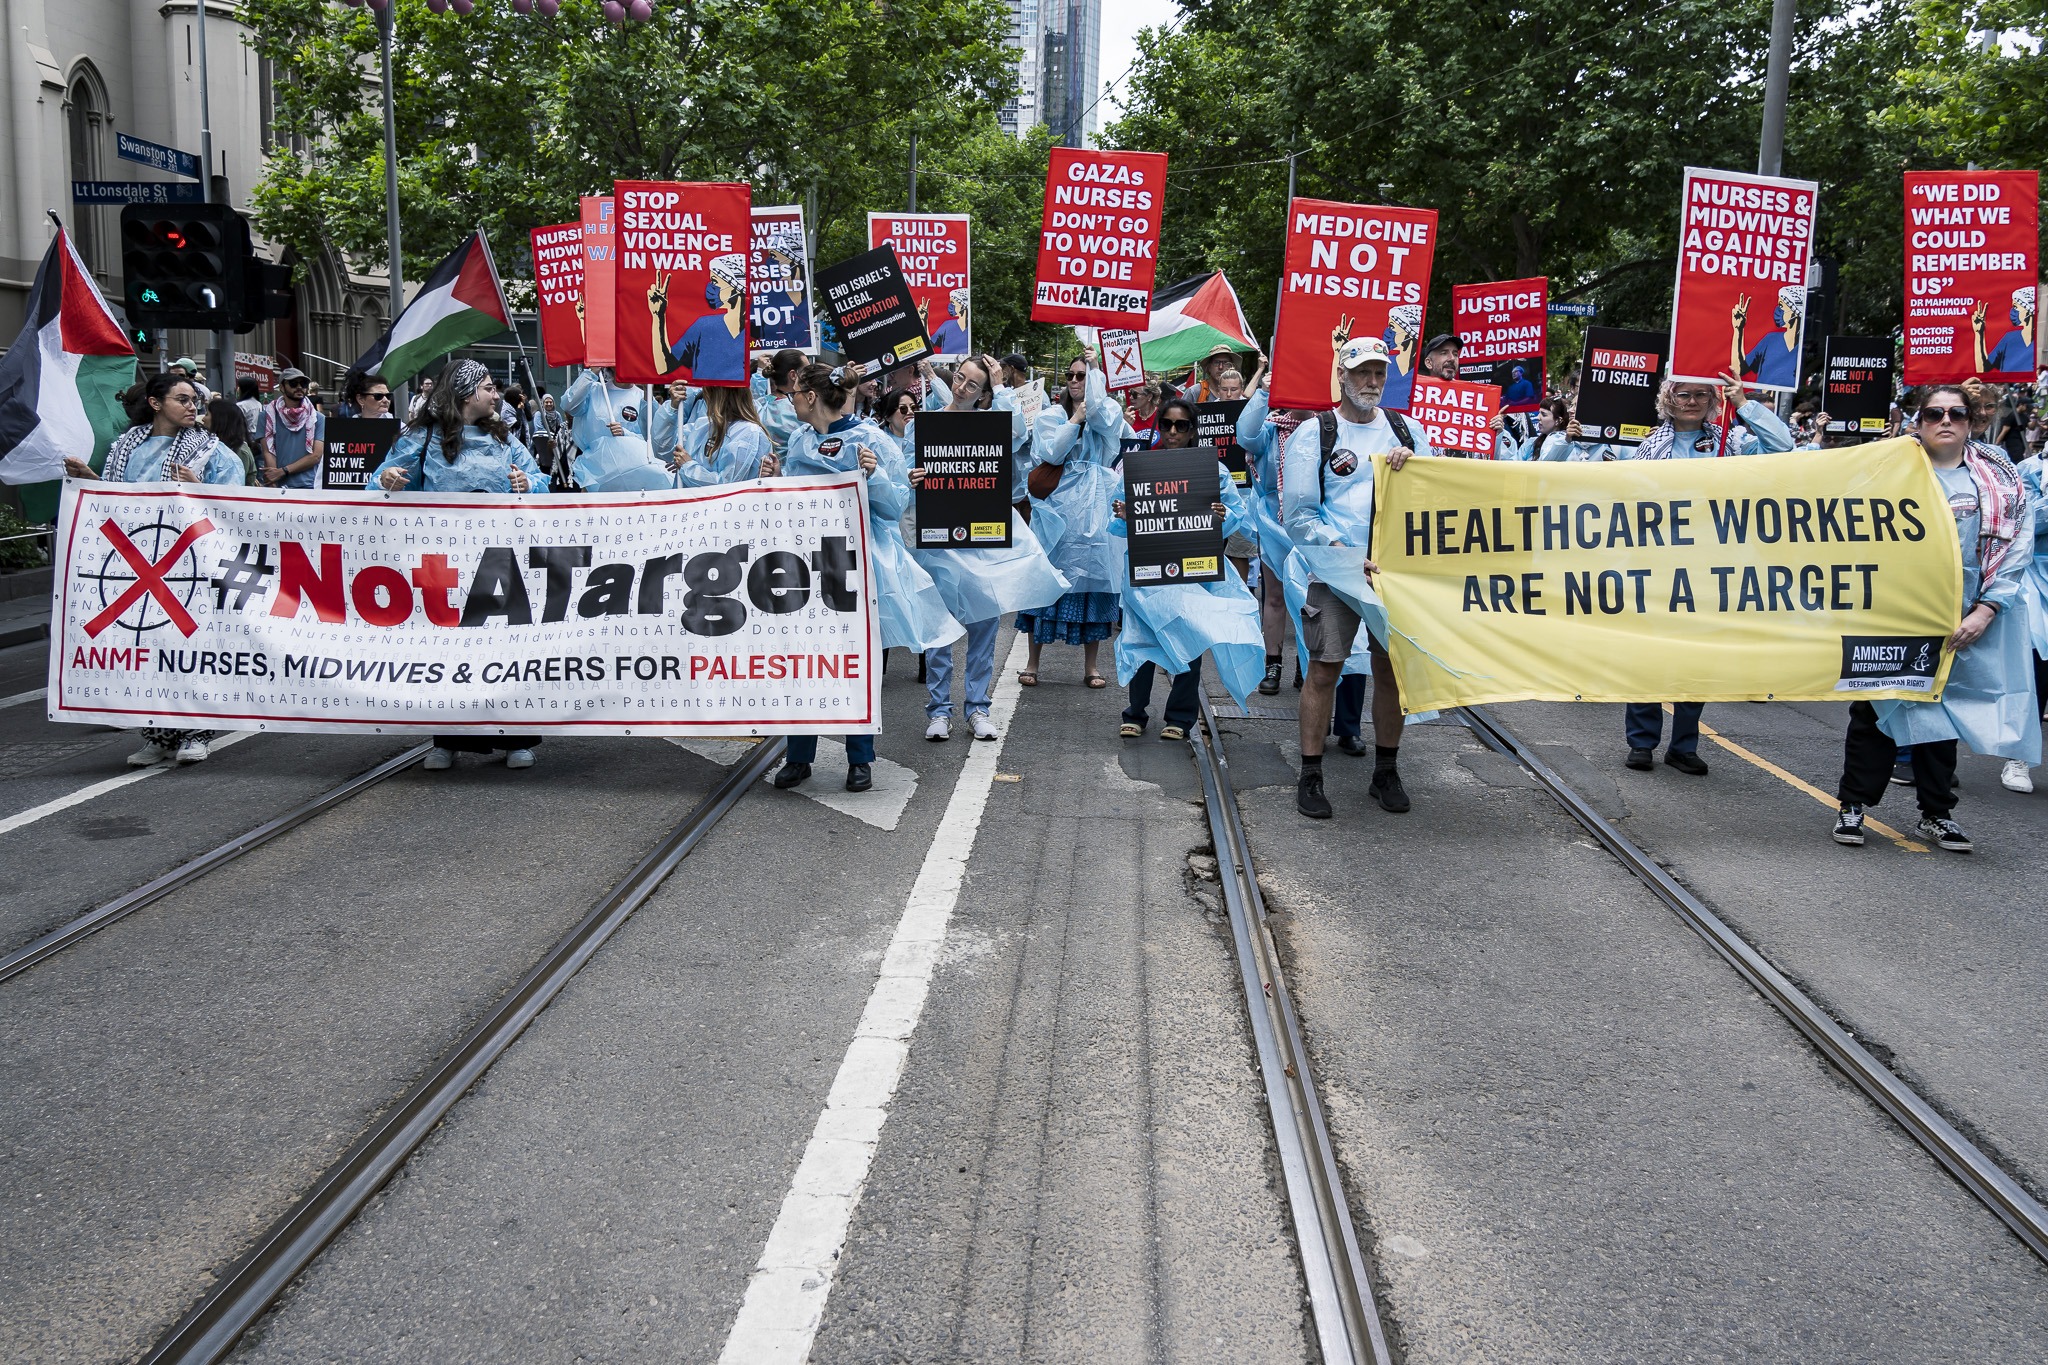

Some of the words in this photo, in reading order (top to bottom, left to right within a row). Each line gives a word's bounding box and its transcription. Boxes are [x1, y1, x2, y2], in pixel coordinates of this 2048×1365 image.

[120, 136, 166, 161] Swanston
[167, 149, 177, 165] St
[1068, 162, 1145, 186] GAZAs
[76, 183, 88, 197] Lt
[92, 183, 150, 197] Lonsdale
[154, 184, 167, 197] St
[1055, 186, 1153, 211] NURSES
[1692, 182, 1790, 213] NURSES
[1794, 195, 1811, 216] &
[1963, 184, 2000, 201] DID
[623, 192, 680, 210] STOP
[623, 212, 708, 231] SEXUAL
[1052, 212, 1116, 232] DON'T
[1119, 217, 1149, 234] GO
[1689, 206, 1809, 239] MIDWIVES
[1911, 208, 1974, 226] WHAT
[1978, 207, 2010, 225] WE
[752, 221, 801, 236] WERE
[891, 222, 947, 237] BUILD
[1295, 213, 1429, 245] MEDICINE
[623, 232, 733, 252] VIOLENCE
[1043, 232, 1073, 252] TO
[1078, 234, 1154, 259] WORK
[1685, 228, 1806, 261] AGAINST
[1911, 230, 1986, 249] COULD
[624, 252, 647, 269] IN
[651, 252, 703, 271] WAR
[901, 256, 939, 271] NOT
[1310, 240, 1410, 276] NOT
[1911, 253, 2027, 272] REMEMBER
[1057, 257, 1087, 277] TO
[1092, 260, 1133, 281] DIE
[1686, 251, 1802, 284] TORTURE
[828, 283, 850, 300] END
[850, 266, 892, 292] ISRAEL'S
[1289, 272, 1421, 304] MISSILES
[543, 289, 579, 306] YOU
[753, 296, 769, 306] BE
[834, 291, 873, 314] ILLEGAL
[1037, 285, 1148, 313] #NotATarget
[1458, 292, 1541, 315] JUSTICE
[1910, 299, 1924, 307] DR
[1925, 297, 1974, 306] MAHMOUD
[840, 295, 900, 328] OCCUPATION
[1547, 303, 1555, 311] Lt
[1555, 304, 1586, 313] Lonsdale
[1910, 308, 1930, 317] ABU
[1930, 307, 1967, 316] NUJAILA
[847, 311, 907, 340] #EndIsraeliOccupation
[1488, 314, 1510, 324] FOR
[1459, 331, 1482, 344] DR
[1485, 325, 1541, 342] ADNAN
[1910, 327, 1954, 336] DOCTORS
[1910, 336, 1953, 345] WITHOUT
[1459, 340, 1539, 359] AL-BURSH
[1910, 346, 1952, 355] BORDERS
[1593, 351, 1610, 366] NO
[1613, 353, 1647, 369] ARMS
[1830, 356, 1887, 368] AMBULANCES
[1592, 369, 1606, 383] TO
[1609, 370, 1650, 387] ISRAEL
[1830, 370, 1847, 380] ARE
[1849, 370, 1866, 381] NOT
[1868, 371, 1873, 381] A
[1829, 383, 1861, 394] TARGET
[1197, 414, 1225, 424] HEALTH
[1197, 425, 1235, 436] WORKERS
[330, 442, 345, 454] WE
[347, 443, 375, 454] CAN'T
[1198, 437, 1213, 447] ARE
[1215, 436, 1230, 447] NOT
[1232, 436, 1237, 445] A
[923, 445, 1003, 458] HUMANITARIAN
[329, 457, 348, 469] SAY
[350, 458, 365, 469] WE
[923, 461, 975, 474] WORKERS
[978, 461, 999, 473] ARE
[328, 472, 361, 483] DIDN'T
[924, 478, 945, 490] NOT
[948, 478, 955, 490] A
[957, 477, 997, 489] TARGET
[1132, 482, 1151, 496] WE
[1155, 480, 1189, 495] CAN'T
[1134, 500, 1155, 514] SAY
[1159, 499, 1178, 513] WE
[1135, 517, 1175, 532] DIDN'T
[1178, 515, 1213, 529] KNOW
[1405, 500, 1695, 557] HEALTHCARE
[1708, 498, 1926, 545] WORKERS
[211, 535, 858, 637] #NotATarget
[1462, 572, 1546, 616] ARE
[1565, 569, 1651, 616] NOT
[1668, 567, 1696, 613] A
[1710, 564, 1879, 612] TARGET
[1852, 646, 1907, 661] AMNESTY
[72, 645, 150, 672] ANMF
[158, 649, 275, 682] NURSES,
[284, 654, 445, 684] MIDWIVES
[452, 662, 474, 684] &
[481, 656, 606, 684] CARERS
[616, 656, 681, 681] FOR
[690, 654, 859, 681] PALESTINE
[1881, 679, 1905, 687] HUMAN
[1906, 679, 1925, 687] RIGHTS
